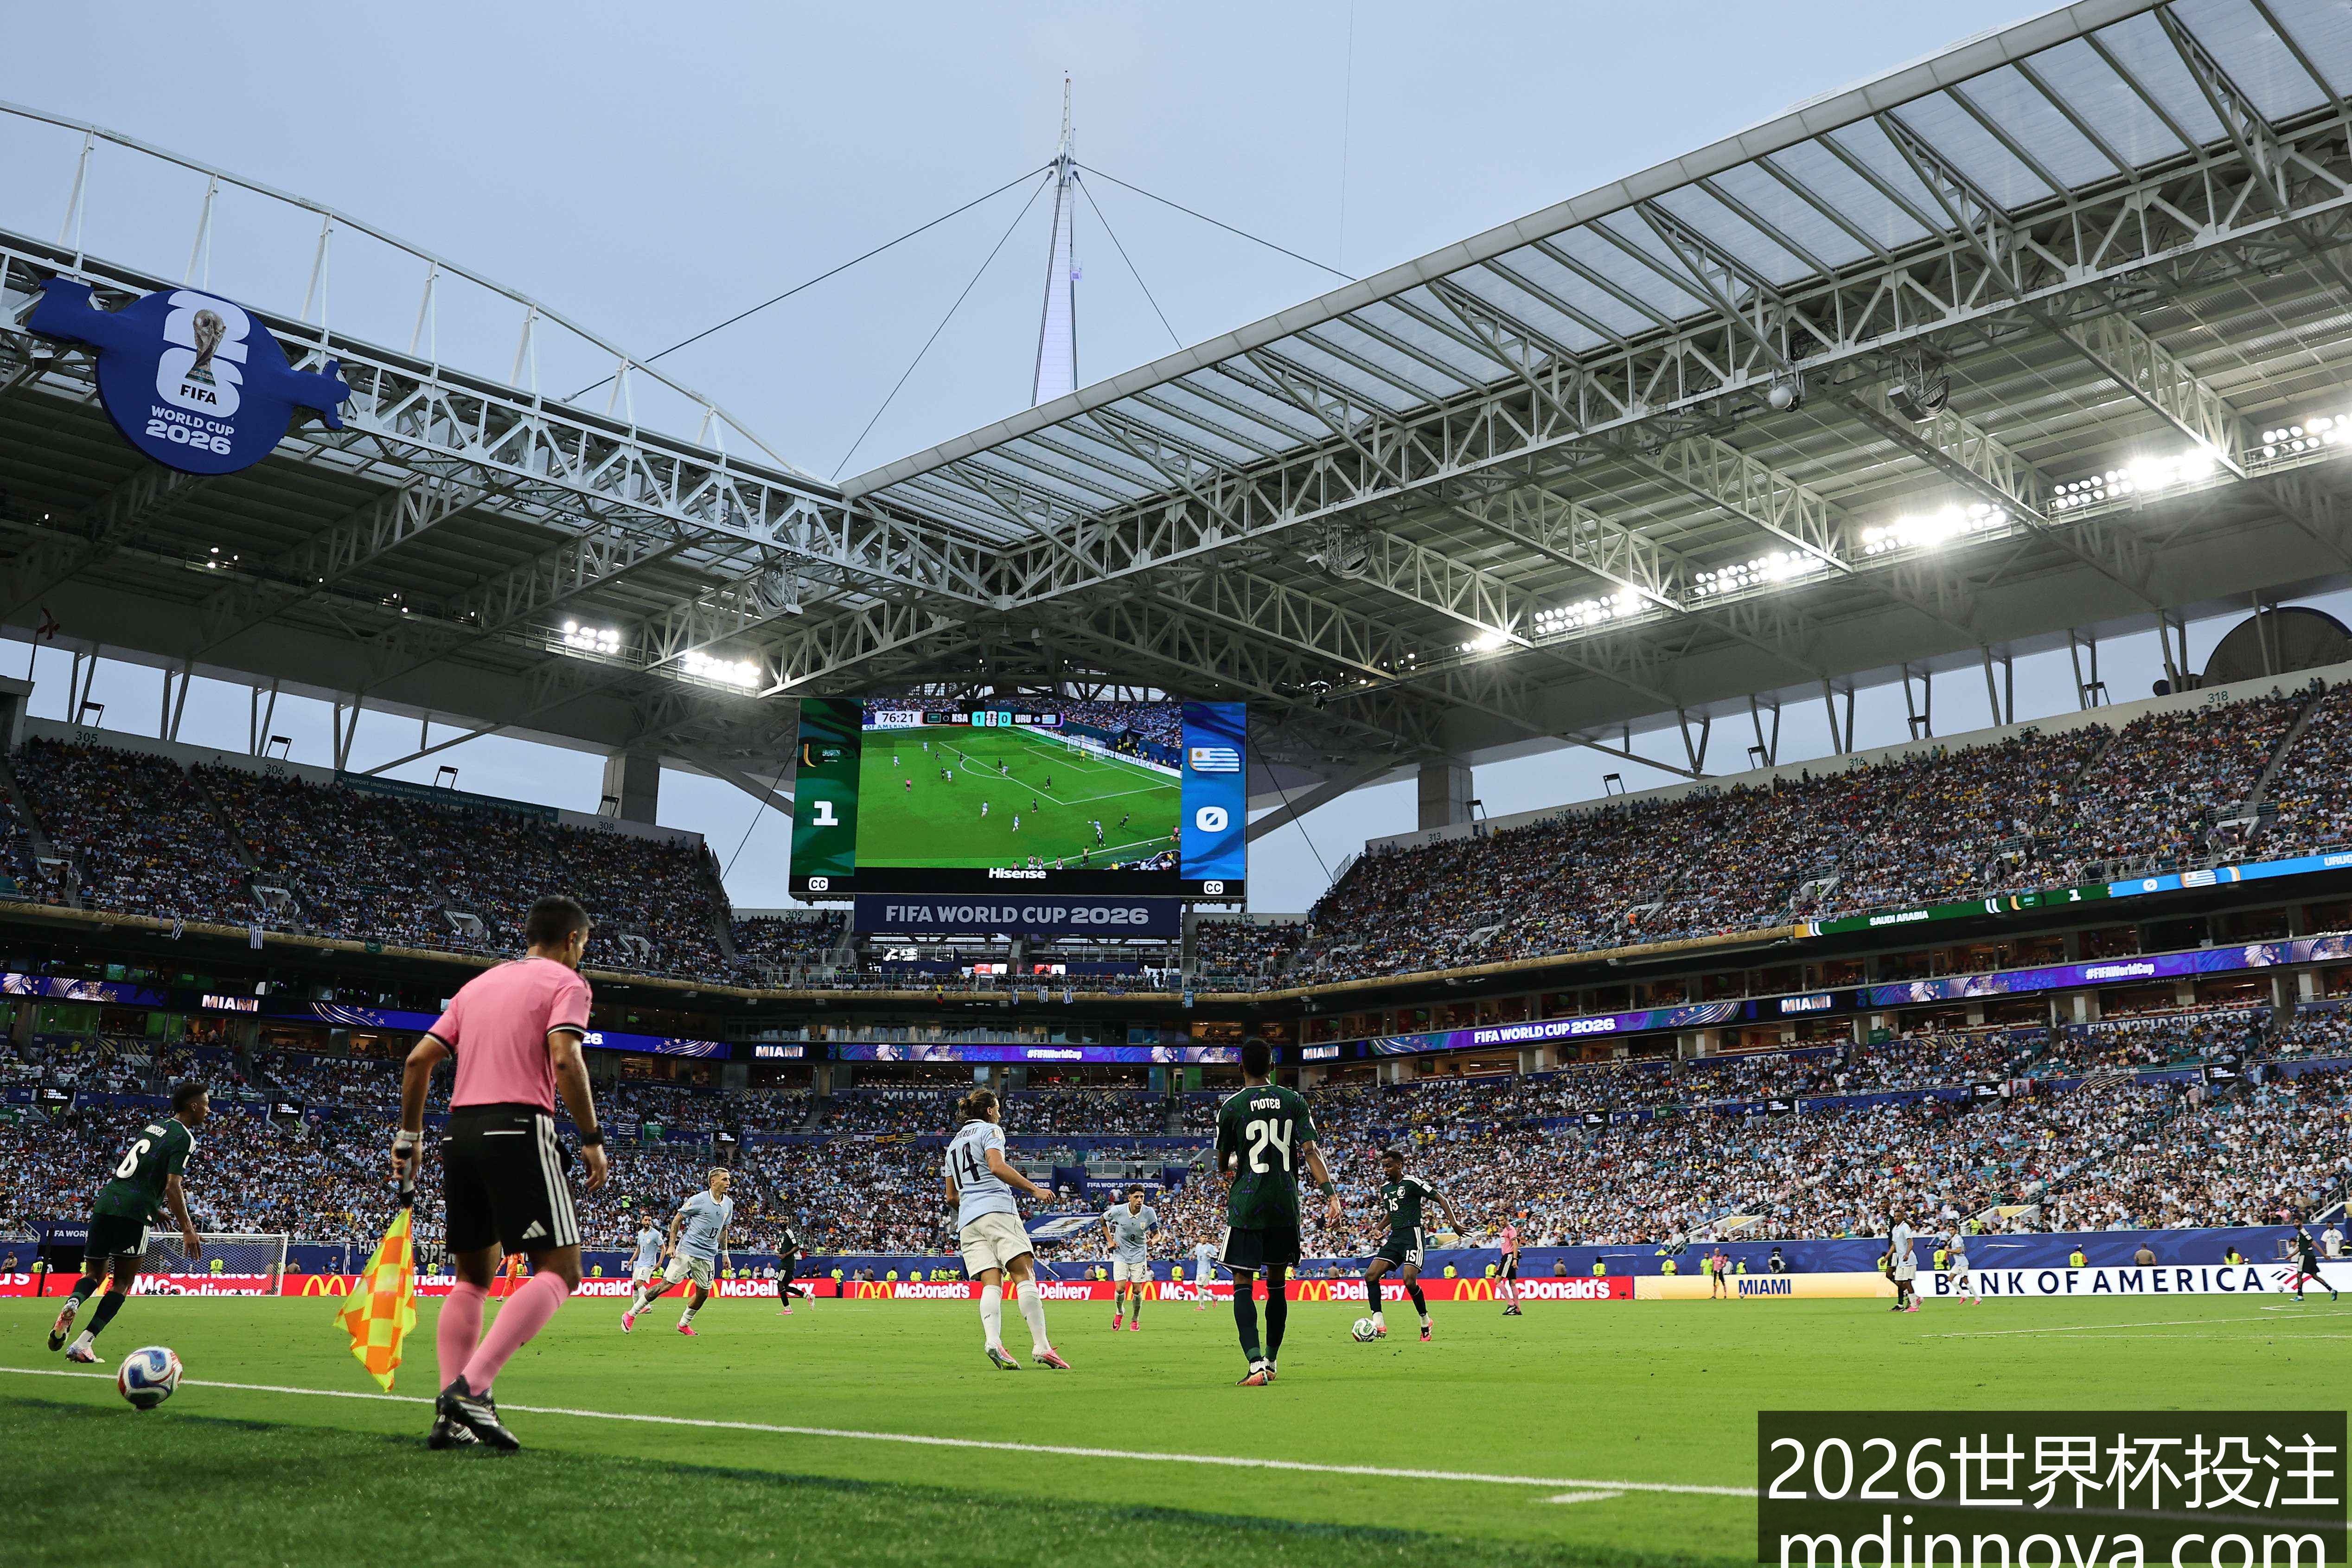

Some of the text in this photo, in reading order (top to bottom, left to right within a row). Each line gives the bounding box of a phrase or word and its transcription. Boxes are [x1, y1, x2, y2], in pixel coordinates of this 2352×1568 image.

[180, 384, 217, 405] FIFA
[151, 405, 235, 436] WORLD CUP
[145, 418, 232, 455] 2026
[2208, 691, 2228, 703] 318
[882, 714, 914, 723] 76:21
[1002, 715, 1007, 723] 0
[1015, 715, 1031, 723] URU
[76, 731, 98, 743] 305
[265, 764, 284, 775] 306
[1849, 757, 1866, 768] 316
[1695, 785, 1710, 795] 315
[813, 801, 838, 826] 1
[1196, 806, 1228, 832] 0
[599, 821, 614, 831] 308
[1429, 832, 1441, 842] 313
[988, 868, 1047, 880] Hisense
[2069, 889, 2082, 902] 1
[786, 910, 804, 920] 309
[886, 907, 1149, 924] FIFA WORLD CUP 2026
[1869, 910, 1930, 927] SAUDI ARABIA
[2086, 964, 2155, 980] #FIFAWorldCup
[202, 995, 259, 1012] MIAMI
[1781, 995, 1831, 1013] MIAMI
[1474, 1018, 1616, 1044] FIFA WORLD CUP 2026
[755, 1046, 803, 1057] MIAMI
[1027, 1049, 1082, 1061] #FIFAWorldCup
[1303, 1046, 1339, 1060] MIAMI
[1250, 1098, 1281, 1112] MOTEB
[1246, 1118, 1293, 1174] 24
[116, 1139, 151, 1178] 6
[951, 1142, 981, 1190] 14
[1388, 1198, 1399, 1212] 15
[709, 1227, 719, 1239] 13
[1406, 1250, 1417, 1262] 15
[1142, 1265, 1146, 1275] 8
[1738, 1280, 1791, 1295] MIAMI
[2038, 1270, 2078, 1294] OF
[2093, 1267, 2264, 1293] AMERICA
[719, 1280, 815, 1298] McDeliery
[894, 1283, 970, 1299] McDonald's
